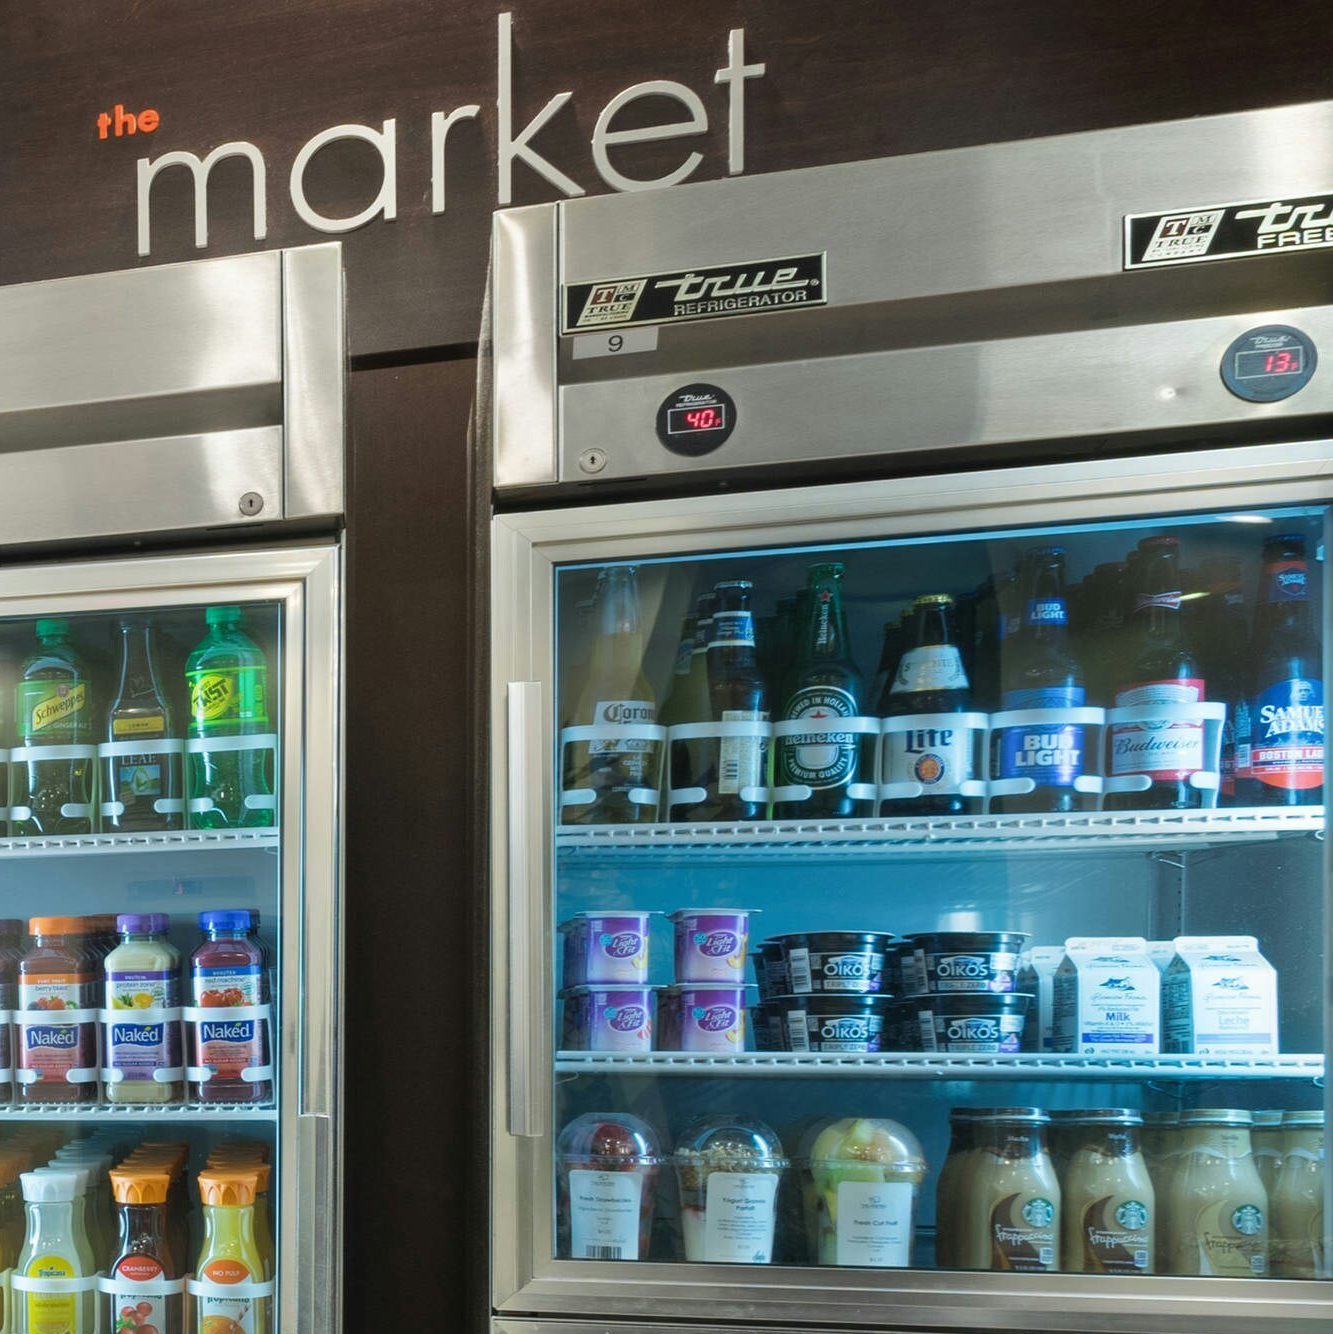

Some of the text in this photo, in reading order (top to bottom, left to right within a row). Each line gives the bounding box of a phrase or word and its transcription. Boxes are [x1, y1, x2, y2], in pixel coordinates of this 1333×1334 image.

[97, 104, 160, 139] the
[136, 11, 765, 257] market
[674, 290, 808, 316] REFRIGERATOR
[608, 335, 623, 352] 9
[687, 410, 715, 428] 40
[1031, 610, 1065, 621] LIGHT
[1036, 602, 1061, 612] BUD
[817, 603, 829, 646] Heineken
[604, 701, 654, 724] Coron
[1260, 704, 1324, 725] SAMUE
[1023, 735, 1074, 751] BUD
[1114, 736, 1201, 754] Budweiser
[1014, 749, 1080, 767] LIGHT
[824, 962, 871, 978] OIKOS
[937, 961, 988, 978] OIKOS
[1105, 1010, 1131, 1022] Milk
[30, 1029, 75, 1046] Naked
[114, 1027, 159, 1044] Naked
[203, 1022, 250, 1041] Naked
[821, 1024, 869, 1039] OIKOS
[947, 1023, 999, 1039] OIKOS
